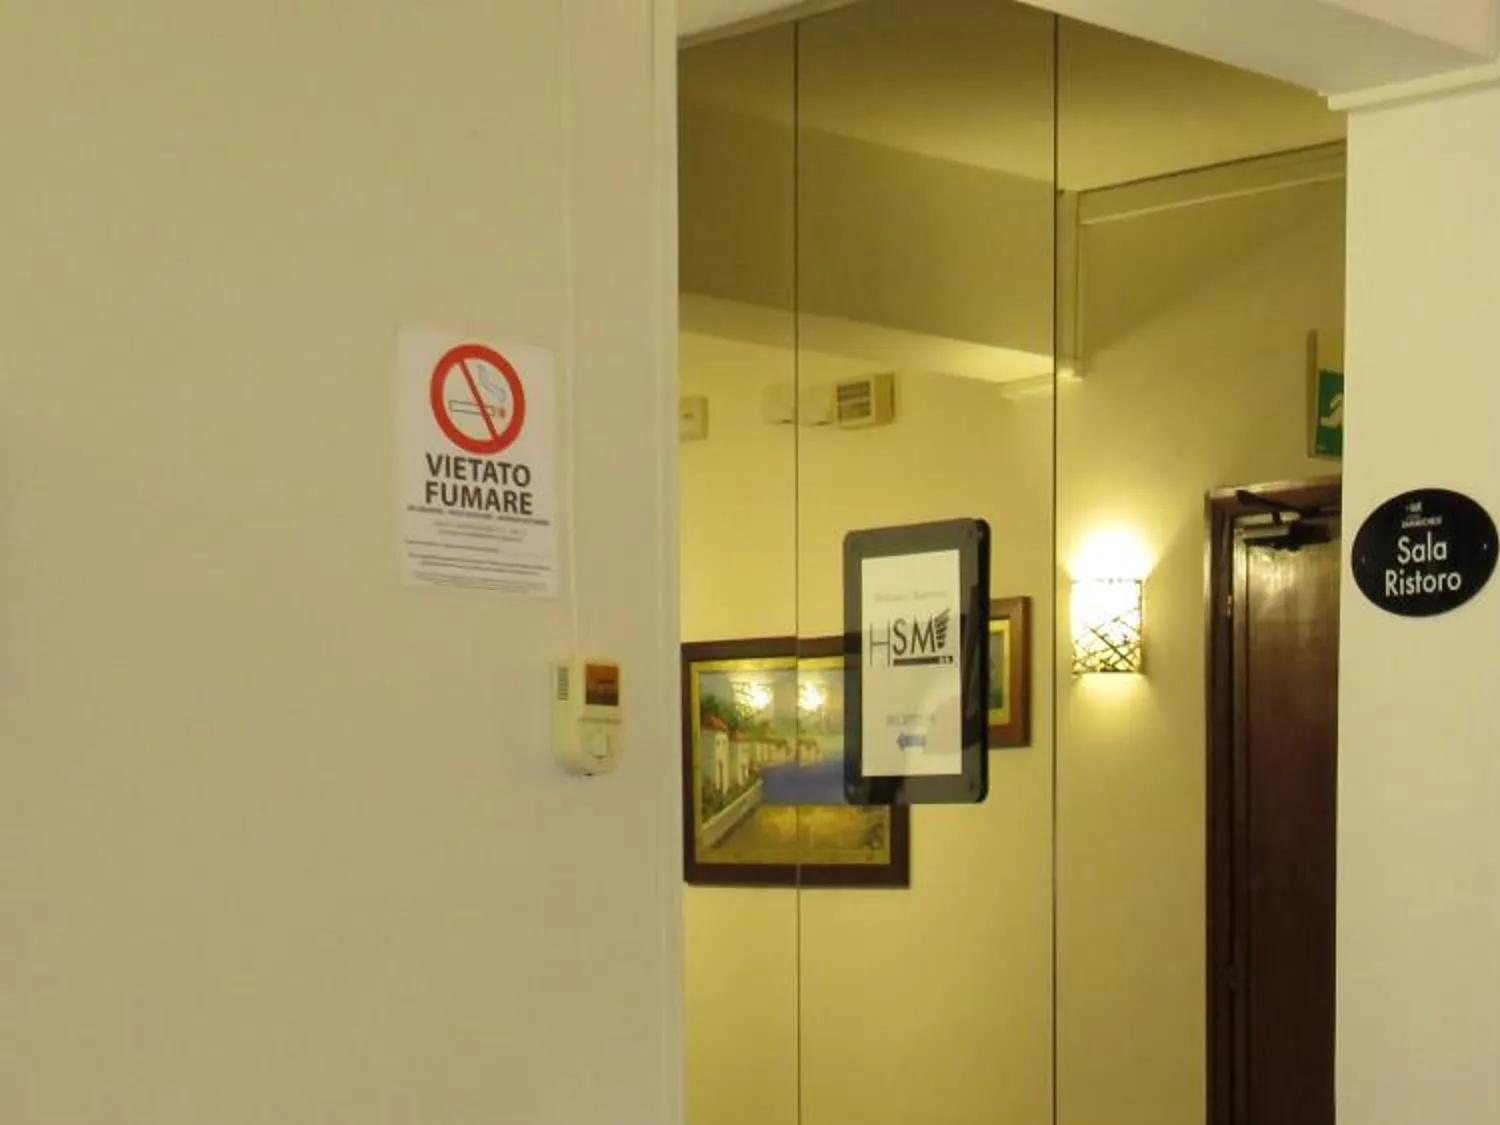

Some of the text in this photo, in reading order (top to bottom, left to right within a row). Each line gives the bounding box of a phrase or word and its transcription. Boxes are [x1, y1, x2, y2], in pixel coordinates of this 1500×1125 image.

[424, 452, 532, 488] VIETATO
[424, 480, 534, 516] FUMARE
[1397, 530, 1448, 565] Sala
[1384, 568, 1462, 597] Ristoro
